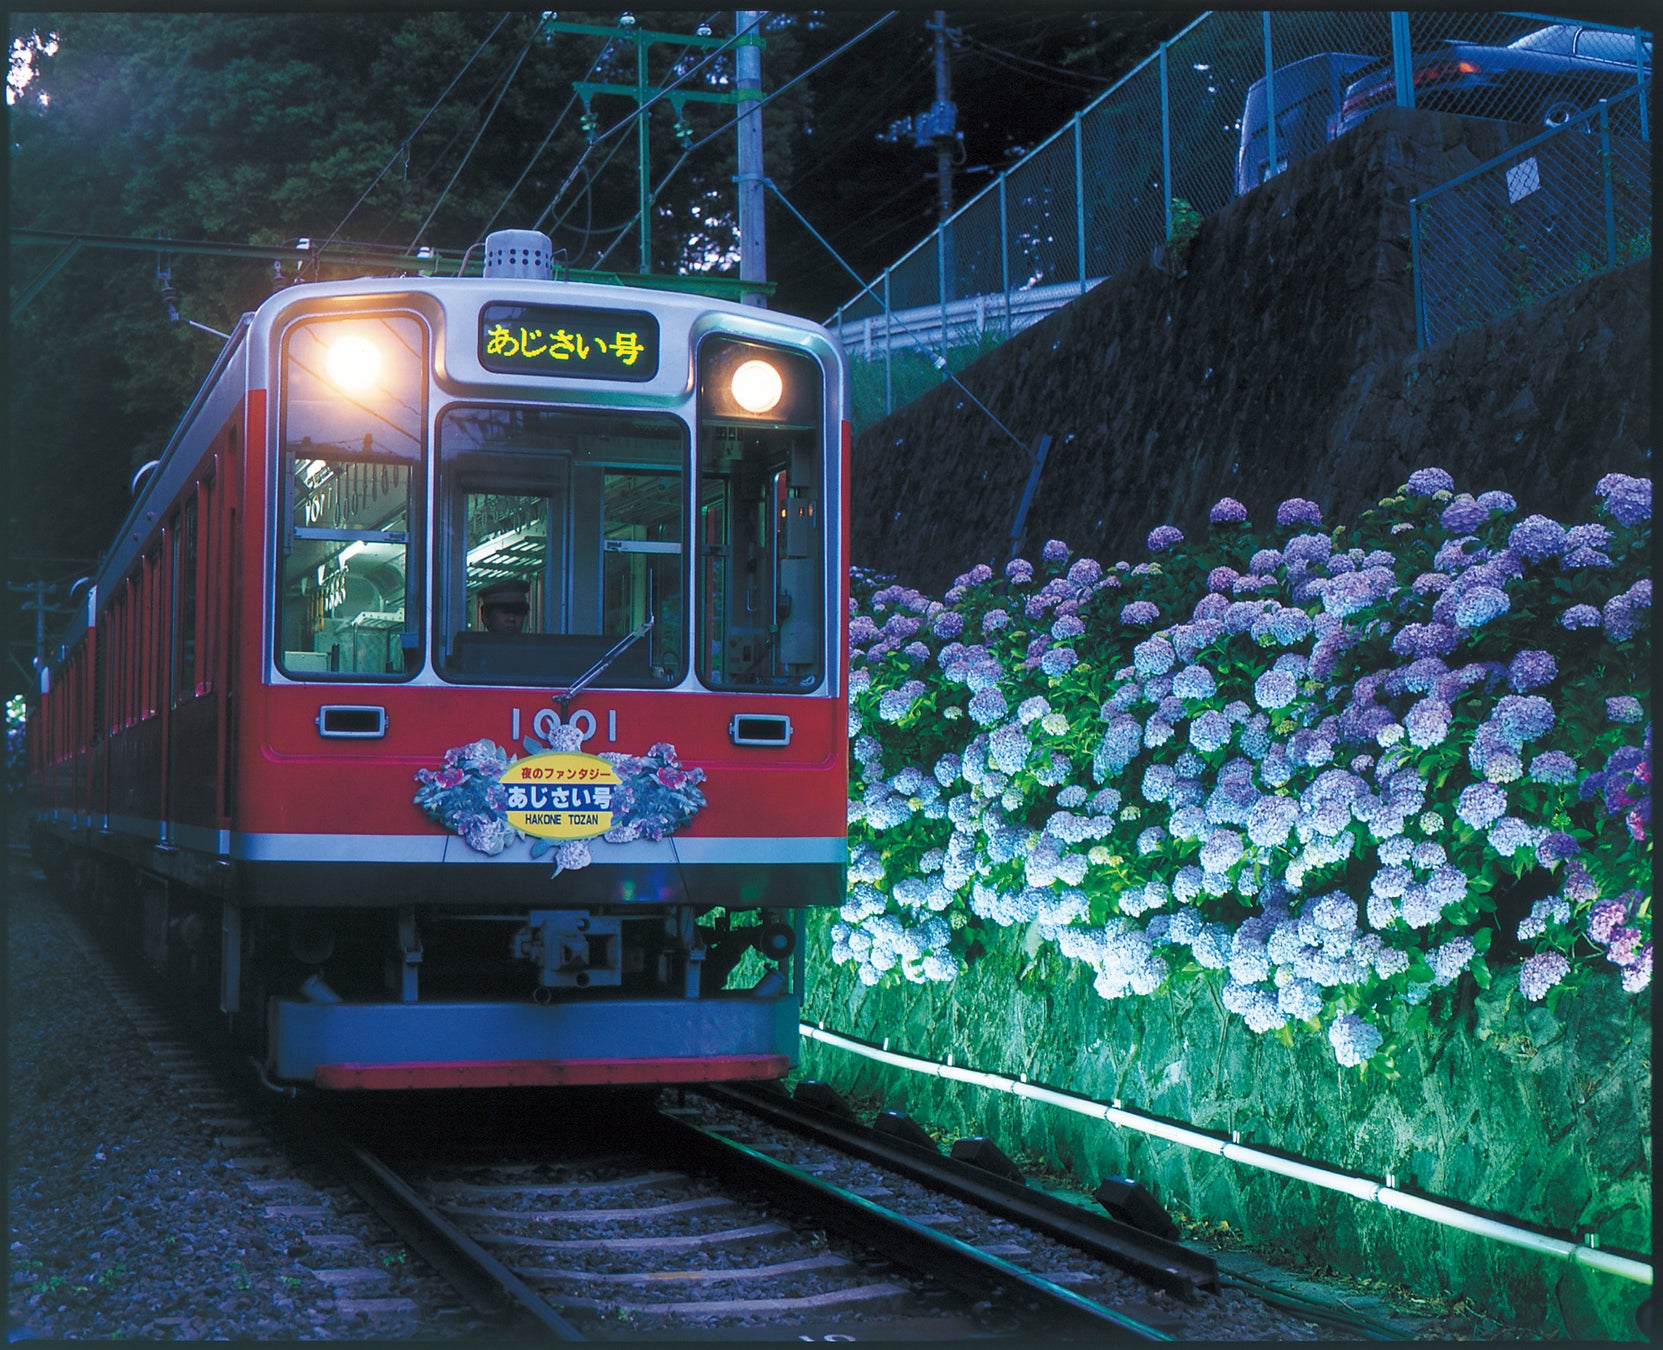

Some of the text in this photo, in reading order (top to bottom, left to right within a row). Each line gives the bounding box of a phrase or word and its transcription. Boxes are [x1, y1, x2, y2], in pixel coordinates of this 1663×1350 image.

[487, 324, 645, 365] あじさい号
[512, 708, 616, 742] 1001
[521, 767, 611, 780] 夜のファンタジー
[508, 786, 613, 809] あじさい号
[525, 814, 599, 825] HAKONE TOZAN
